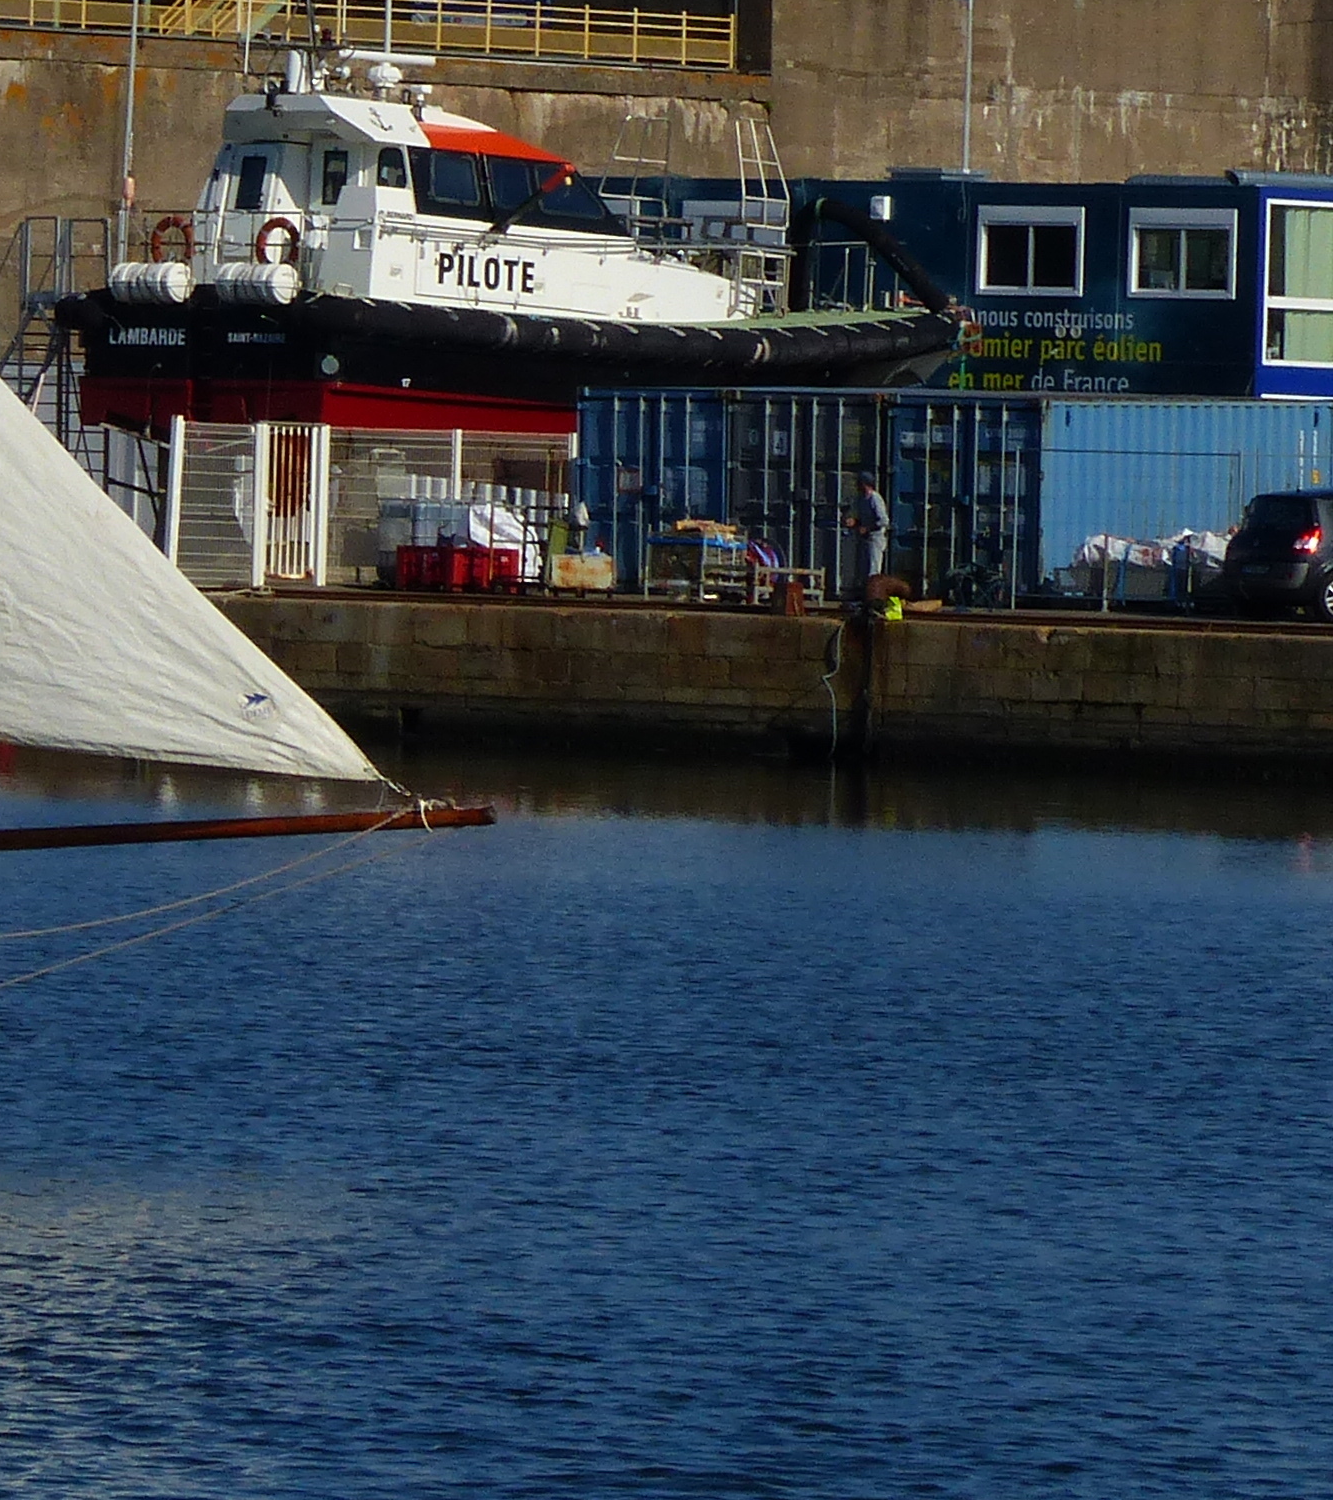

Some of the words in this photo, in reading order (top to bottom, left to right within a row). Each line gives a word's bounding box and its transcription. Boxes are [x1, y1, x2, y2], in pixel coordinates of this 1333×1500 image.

[438, 252, 535, 293] PILOTE
[978, 308, 1018, 327] nous
[1024, 307, 1134, 330] construisons
[109, 327, 186, 346] LAMBARDE
[1040, 337, 1085, 366] parc
[1093, 334, 1162, 362] éolien
[984, 372, 1024, 390] mer
[1031, 368, 1055, 390] de
[1064, 369, 1129, 391] France
